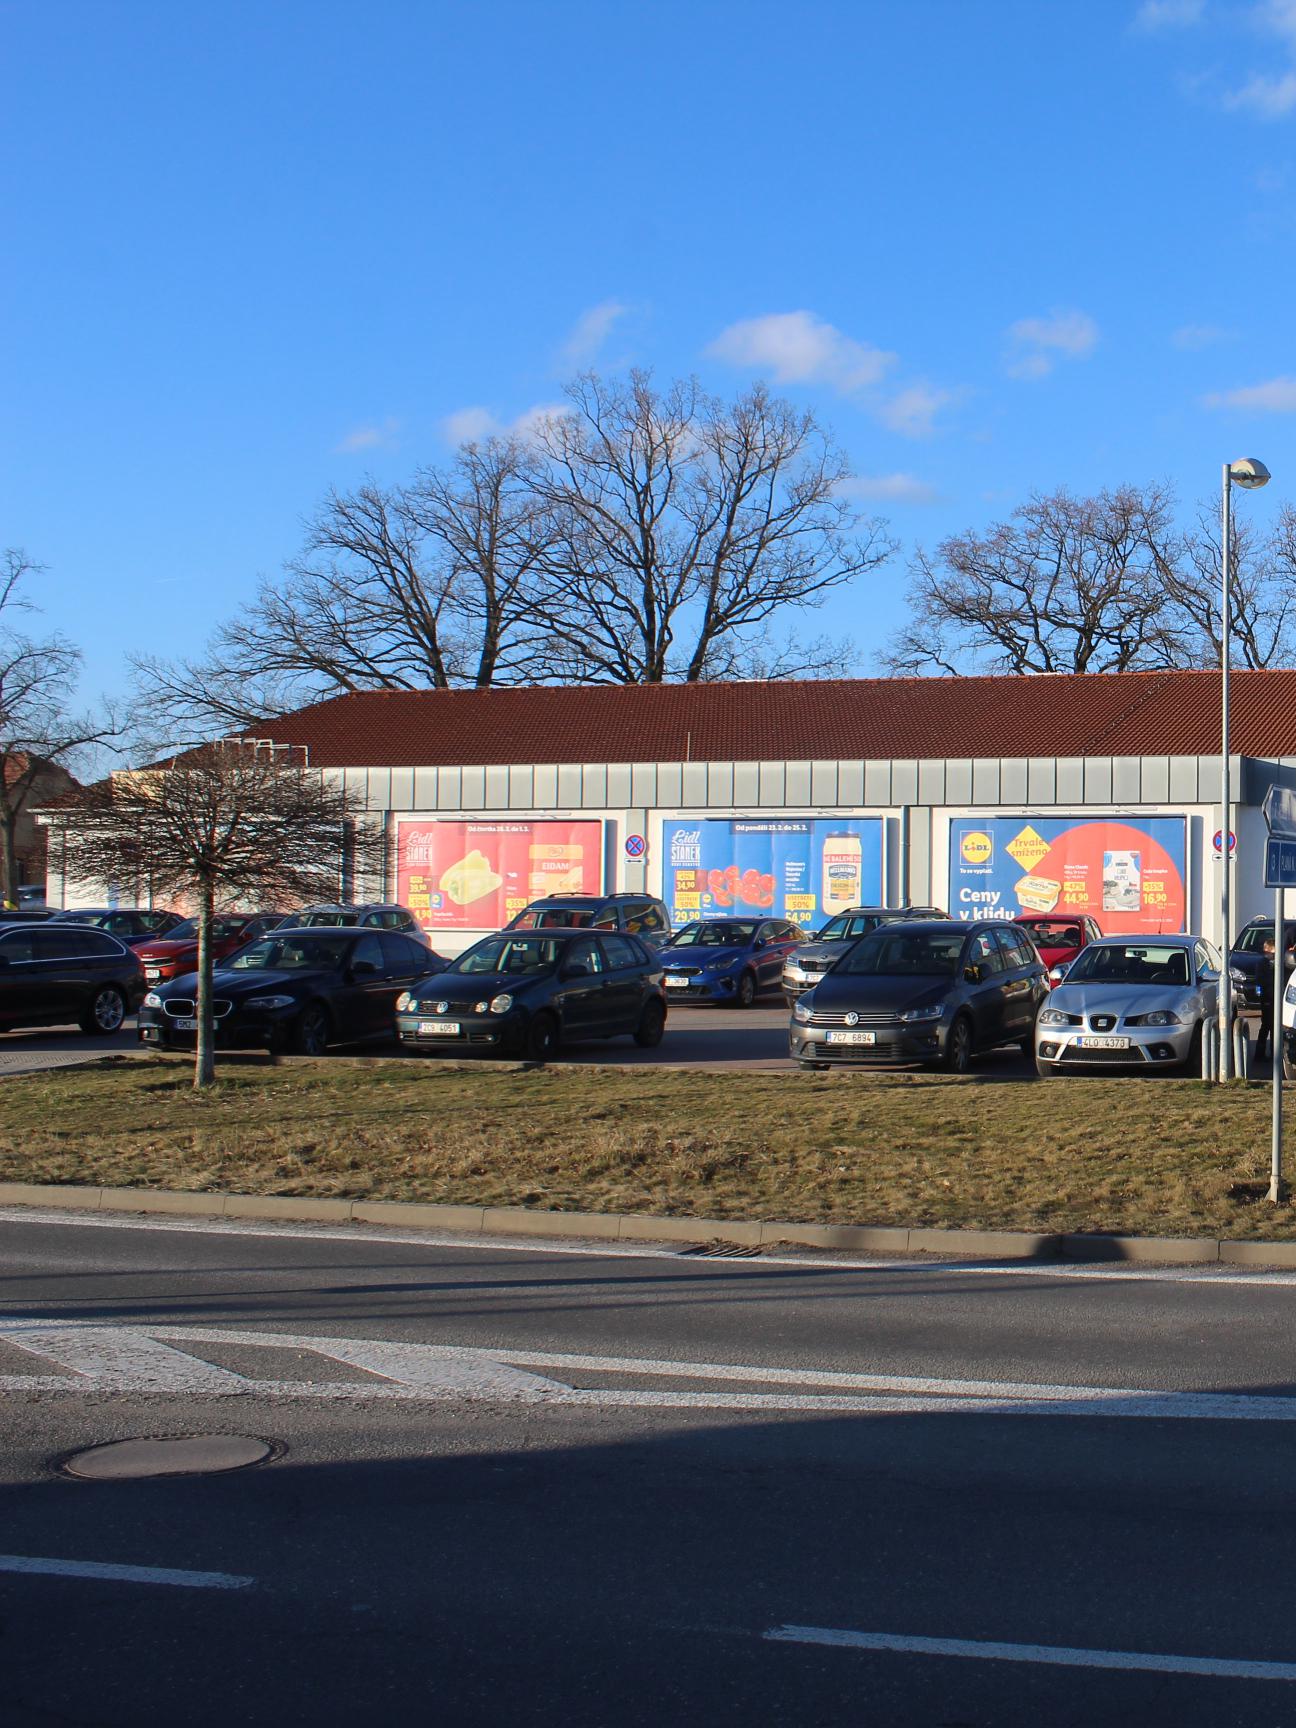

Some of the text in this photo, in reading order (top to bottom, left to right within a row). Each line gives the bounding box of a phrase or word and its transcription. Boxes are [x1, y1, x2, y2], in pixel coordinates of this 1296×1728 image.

[1014, 838, 1044, 847] Trvale
[1012, 848, 1048, 857] sníženo
[960, 888, 1000, 905] Ceny
[960, 910, 970, 920] v
[833, 1033, 871, 1042] 7C7 6894
[1105, 1038, 1125, 1047] 4373
